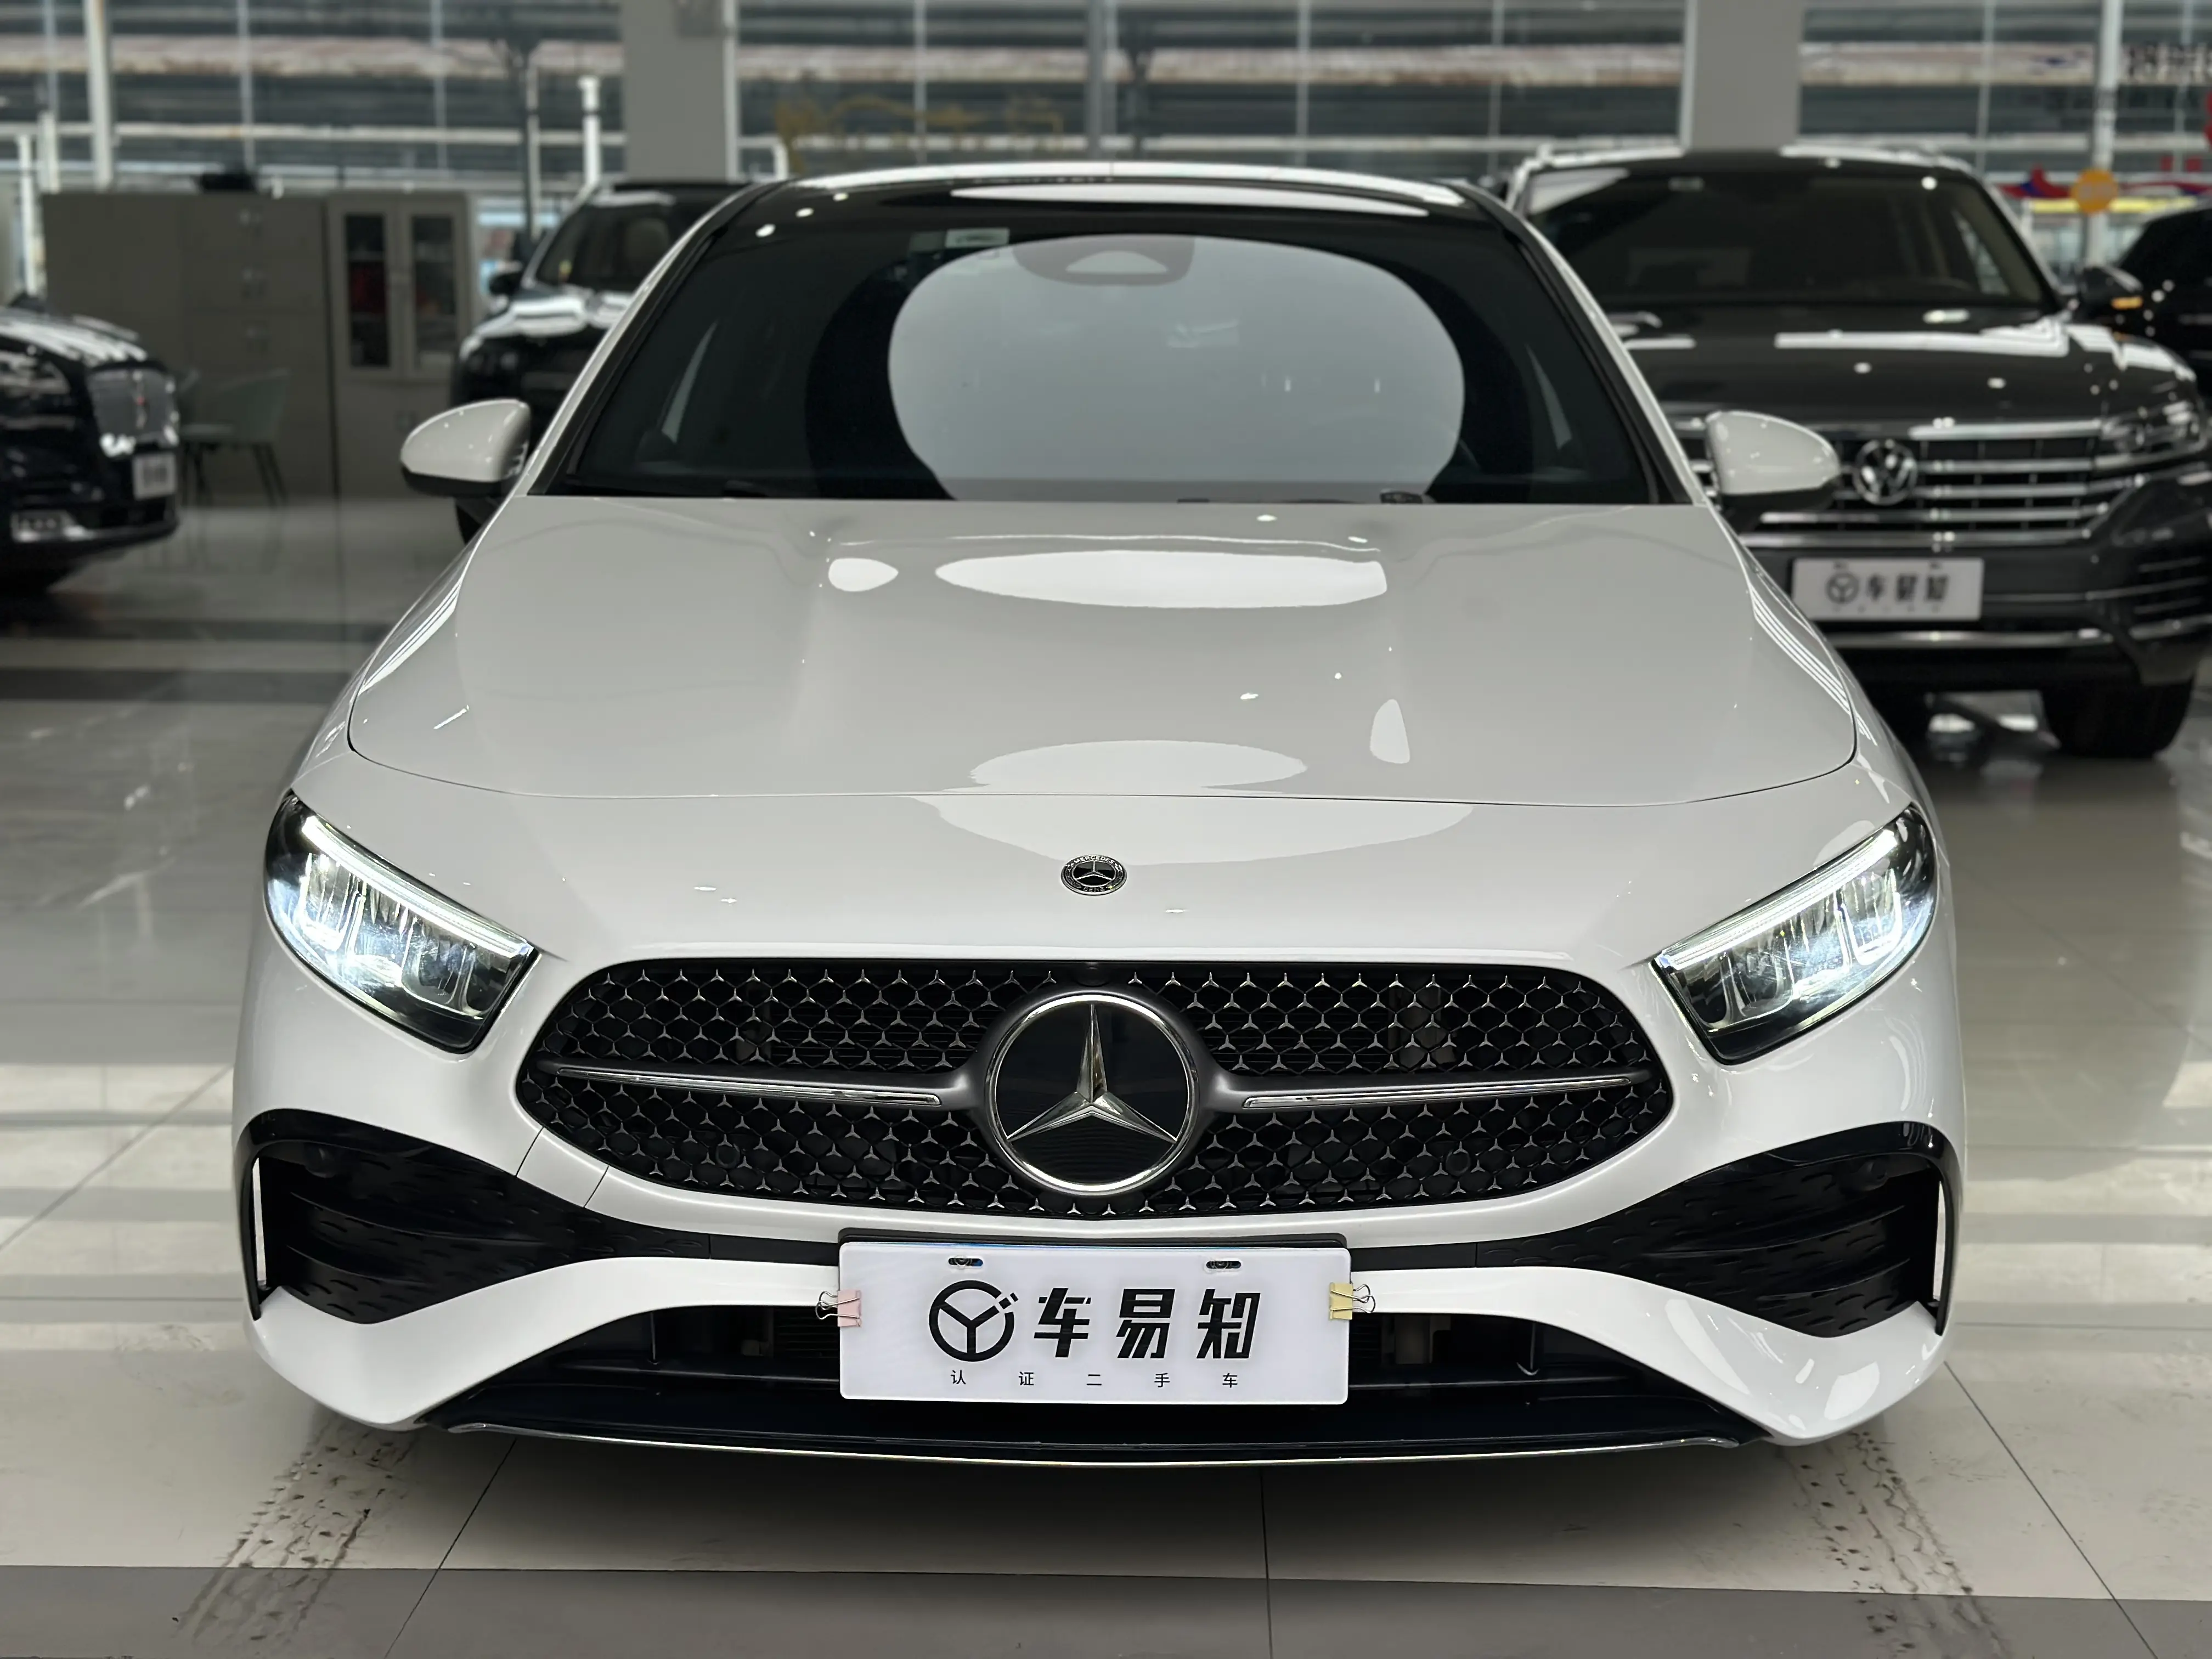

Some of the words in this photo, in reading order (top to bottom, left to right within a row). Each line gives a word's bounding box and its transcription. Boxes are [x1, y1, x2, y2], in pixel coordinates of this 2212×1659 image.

[1074, 855, 1115, 865] MERCEDES
[1033, 1287, 1261, 1359] 车易知
[950, 1369, 1238, 1389] 认证二手车
